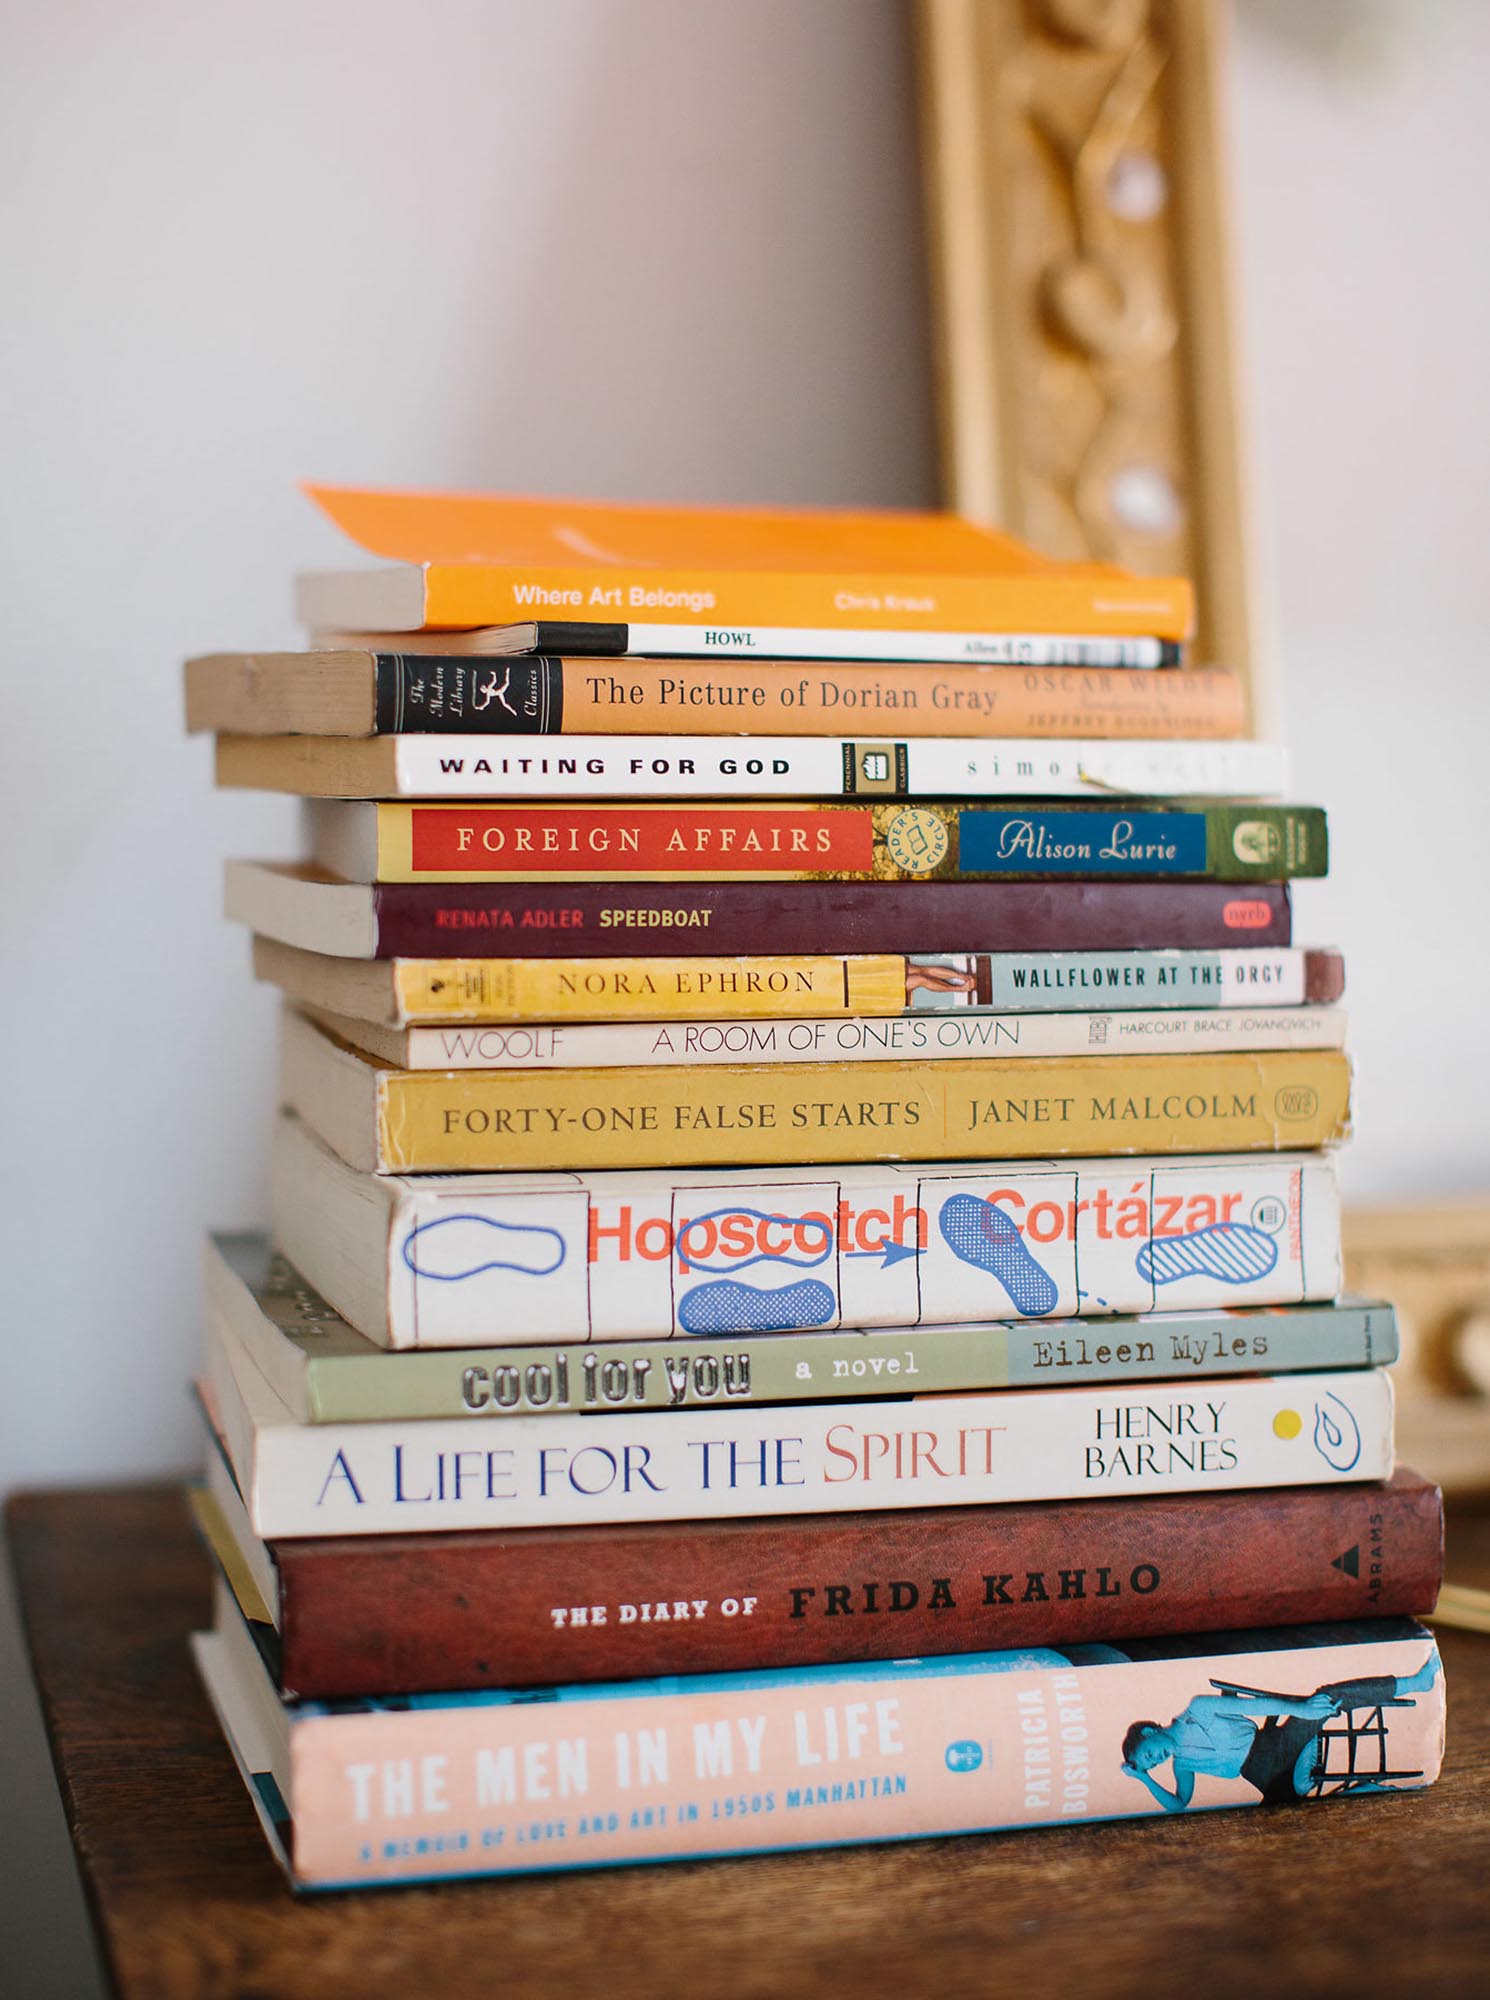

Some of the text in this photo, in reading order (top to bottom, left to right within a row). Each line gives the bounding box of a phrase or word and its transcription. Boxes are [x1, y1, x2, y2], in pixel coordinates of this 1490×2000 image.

[513, 586, 715, 612] Where Art Belongs
[704, 631, 756, 646] HOWL
[411, 678, 425, 703] The
[430, 667, 444, 718] Modern
[450, 667, 466, 717] Library
[523, 669, 537, 716] Classics
[586, 678, 998, 715] The Picture of Dorian Gray
[1023, 673, 1113, 692] OSCAR
[440, 759, 790, 774] WAITING FOR GOD
[844, 744, 852, 791] PERENNIAL
[898, 747, 906, 789] CLASSICS
[457, 828, 832, 852] FOREIGN AFFAIRS
[996, 819, 1177, 859] Alison Lurie
[435, 909, 584, 928] RENATA ADLER
[600, 910, 712, 928] SPEEDBOAT
[1229, 904, 1265, 921] nyrb
[559, 971, 815, 994] NORA EPHRON
[1012, 965, 1283, 988] WALLFLOWER AT THE ORGY
[441, 1028, 564, 1060] WOOLF
[651, 1020, 1020, 1053] A ROOM OF ONE'S OWN
[1119, 1017, 1321, 1035] HARCOURT BRACE JOVANOVICH
[442, 1101, 920, 1134] FORTY-ONE FALSE STARTS
[968, 1093, 1257, 1130] JANET MALCOLM
[980, 1181, 1243, 1244] Cortázar
[1288, 1167, 1302, 1261] PANTHEON
[588, 1195, 928, 1275] Hopscotch
[795, 1352, 919, 1379] a novel
[1034, 1331, 1268, 1368] Eileen Myles
[462, 1352, 752, 1412] cool for you
[1096, 1401, 1226, 1440] HENRY
[317, 1424, 1008, 1506] A LIFE FOR THE SPIRIT
[1084, 1438, 1238, 1479] BARNES
[1366, 1513, 1383, 1603] ABRAMS
[551, 1564, 1161, 1628] THE DIARY OF FRIDA KAHLO
[346, 1698, 904, 1821] THE MEN IN MY LIFE
[1017, 1688, 1051, 1808] PATRICIA
[1051, 1673, 1089, 1814] BOSWORTH
[577, 1812, 619, 1836] AND
[630, 1805, 667, 1829] ART
[677, 1803, 698, 1823] IN
[786, 1774, 907, 1809] MANHATTAN
